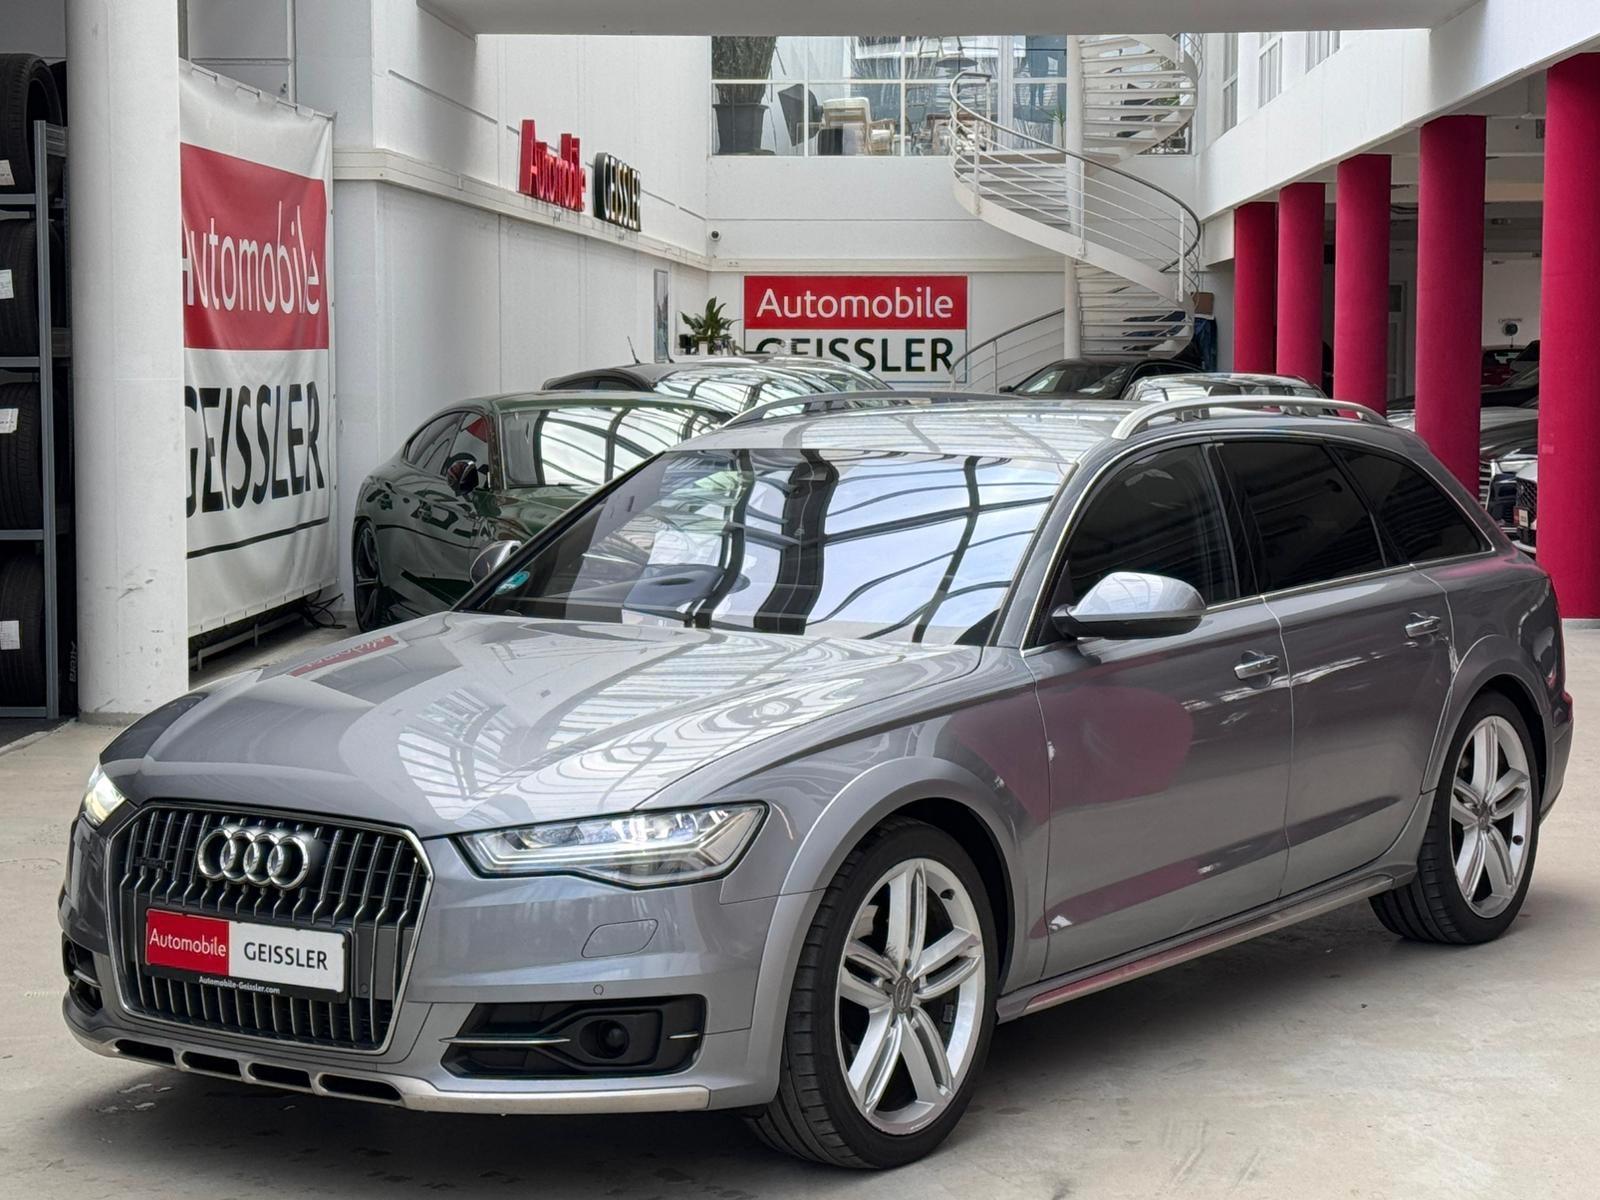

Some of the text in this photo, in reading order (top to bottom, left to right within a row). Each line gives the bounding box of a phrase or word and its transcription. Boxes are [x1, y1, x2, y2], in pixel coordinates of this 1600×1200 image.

[756, 286, 954, 318] Automobile
[149, 928, 328, 970] Automobile GEISSLER
[198, 975, 281, 995] Automobile-Geissler.com
